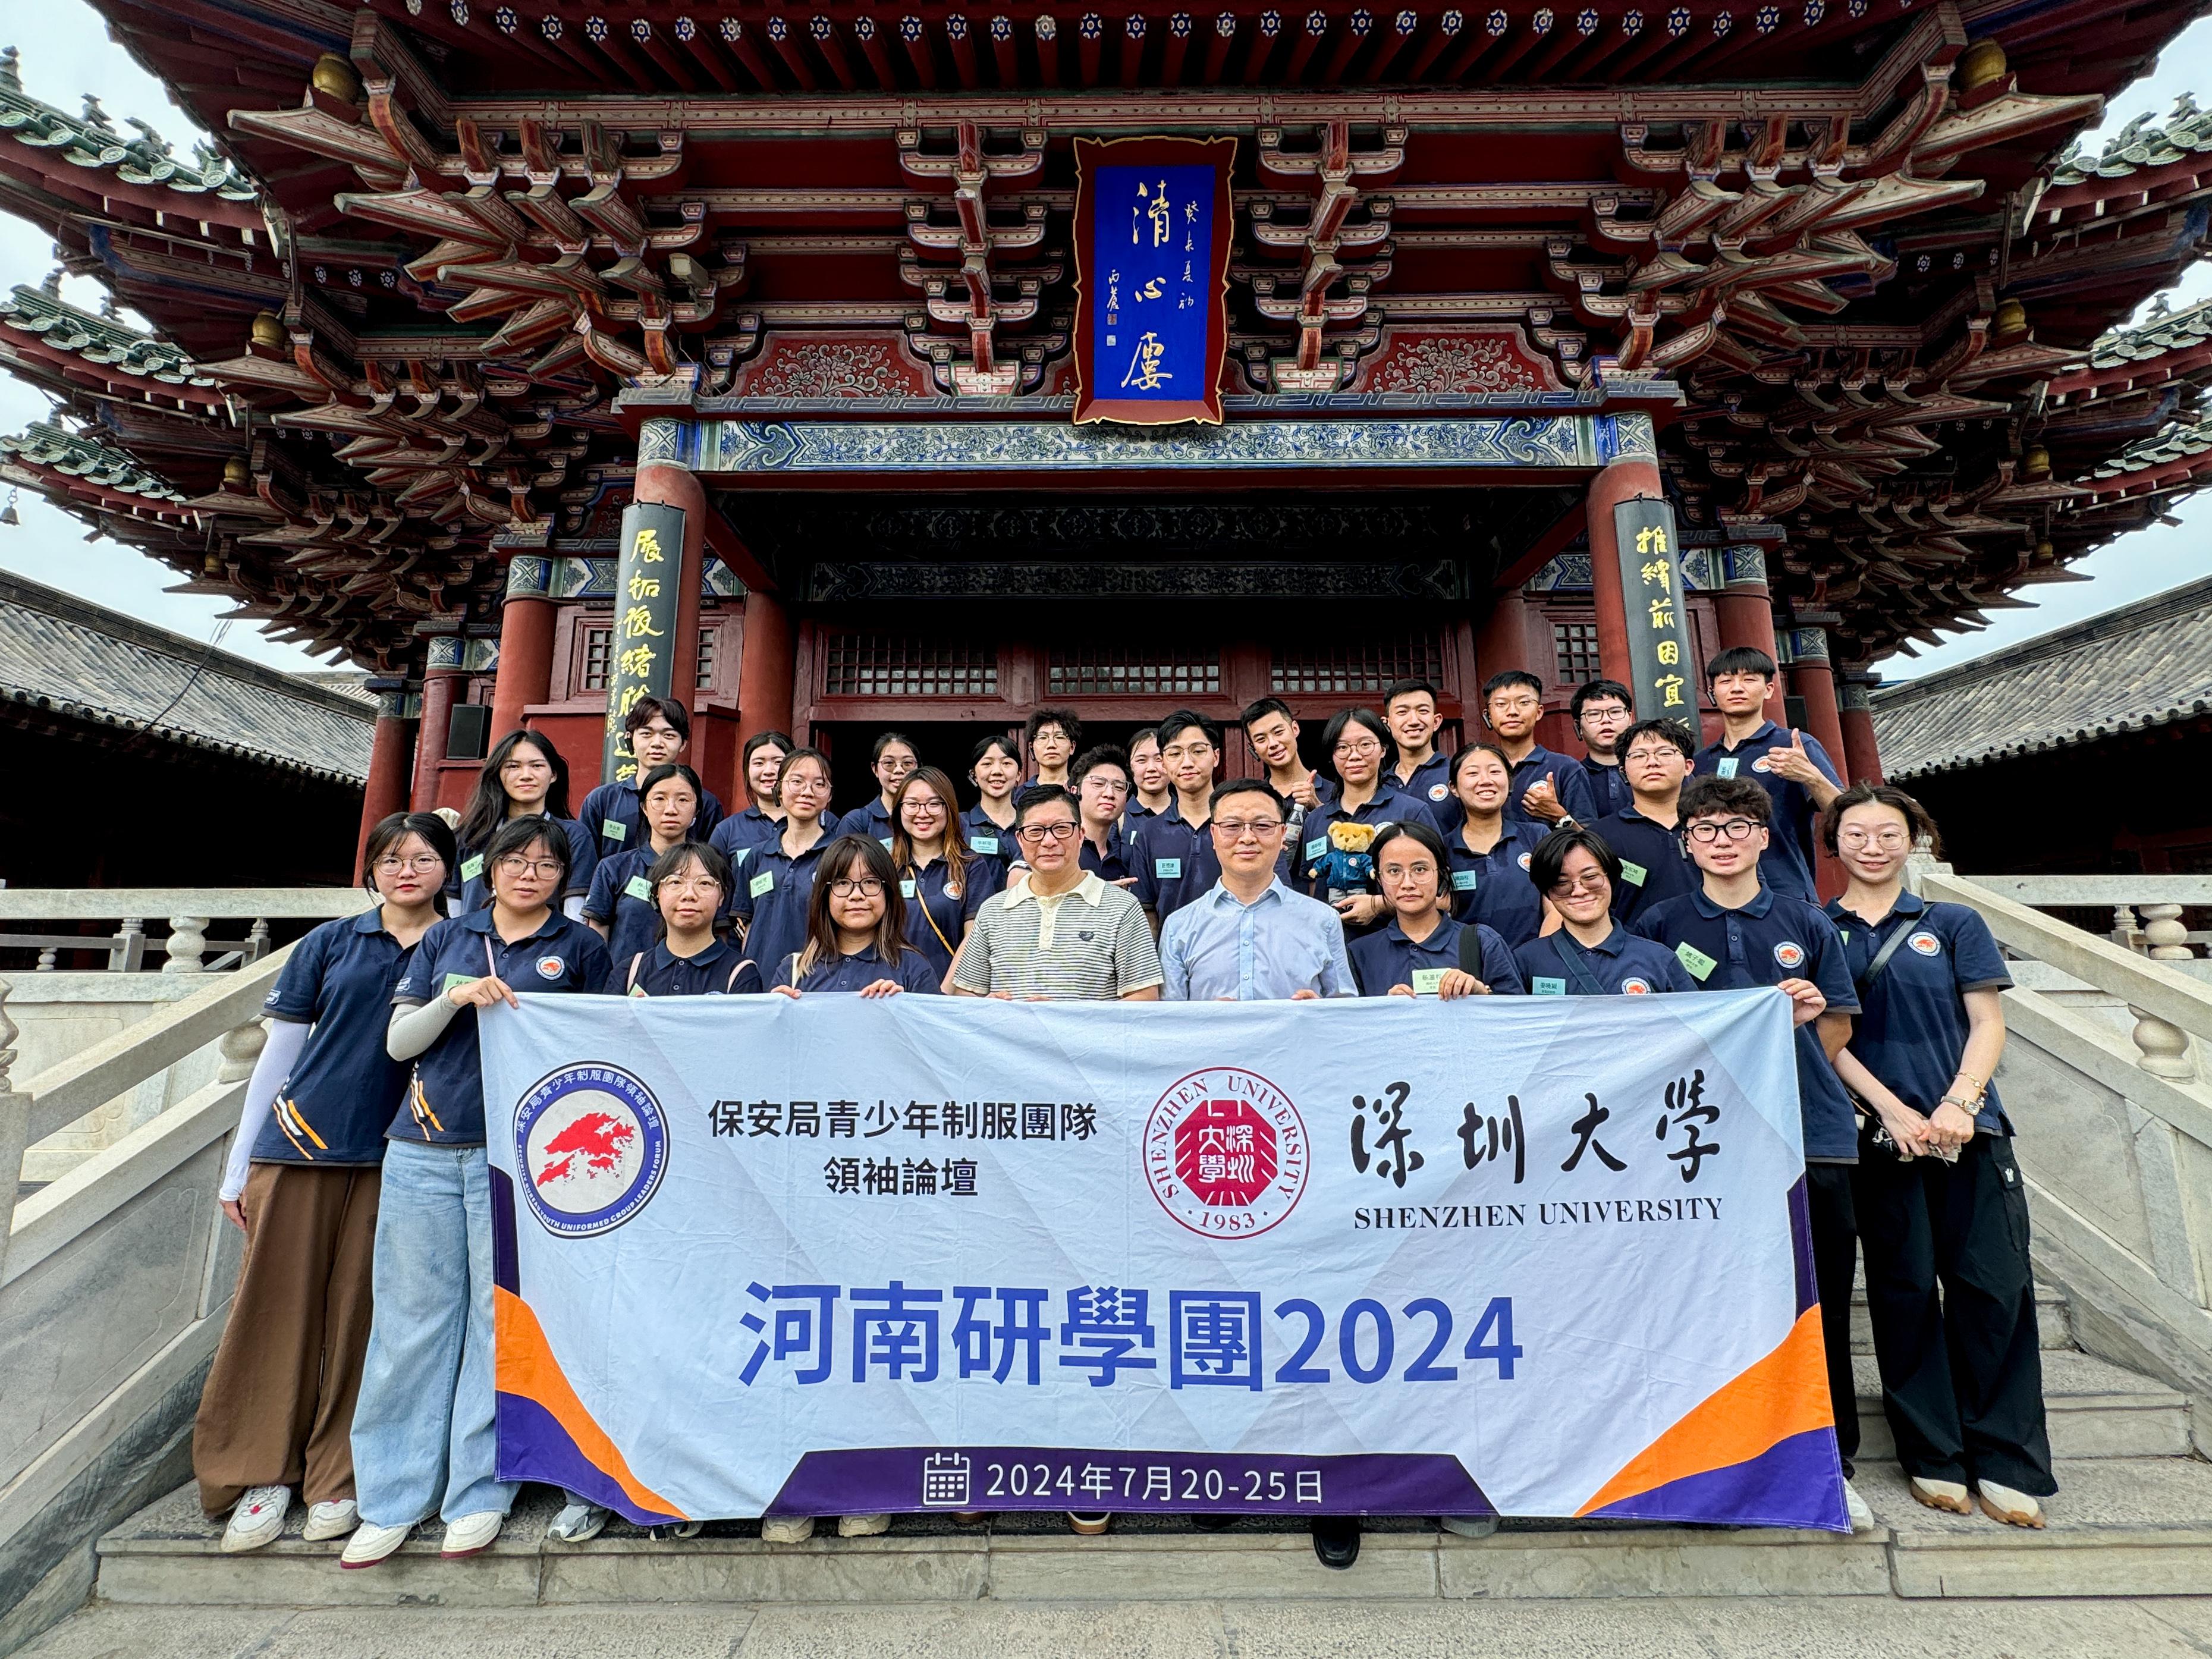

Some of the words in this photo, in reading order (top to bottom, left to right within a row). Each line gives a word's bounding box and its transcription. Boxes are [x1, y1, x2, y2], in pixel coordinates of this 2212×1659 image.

[517, 1069, 659, 1133] 保安局青少年制服團隊領袖論壇
[708, 1099, 1097, 1141] 保安局青少年制服團隊
[1151, 1077, 1209, 1199] SHENZHEN
[1227, 1075, 1302, 1200] UNIVERSITY
[518, 1144, 528, 1182] SECURITY
[525, 1183, 541, 1211] BUREAU
[540, 1210, 560, 1228] YOUTH
[561, 1217, 610, 1231] UNIFORMED
[610, 1202, 635, 1222] GROUP
[635, 1170, 658, 1204] LEADERS
[652, 1140, 662, 1169] FORUM
[823, 1157, 978, 1196] 領袖論壇
[1199, 1211, 1256, 1231] 1983
[1355, 1204, 1527, 1230] SHENZHEN
[1539, 1197, 1723, 1225] UNIVERSITY
[738, 1280, 1524, 1392] 河南研學團2024
[986, 1462, 1323, 1504] 2024年7月20-25日
